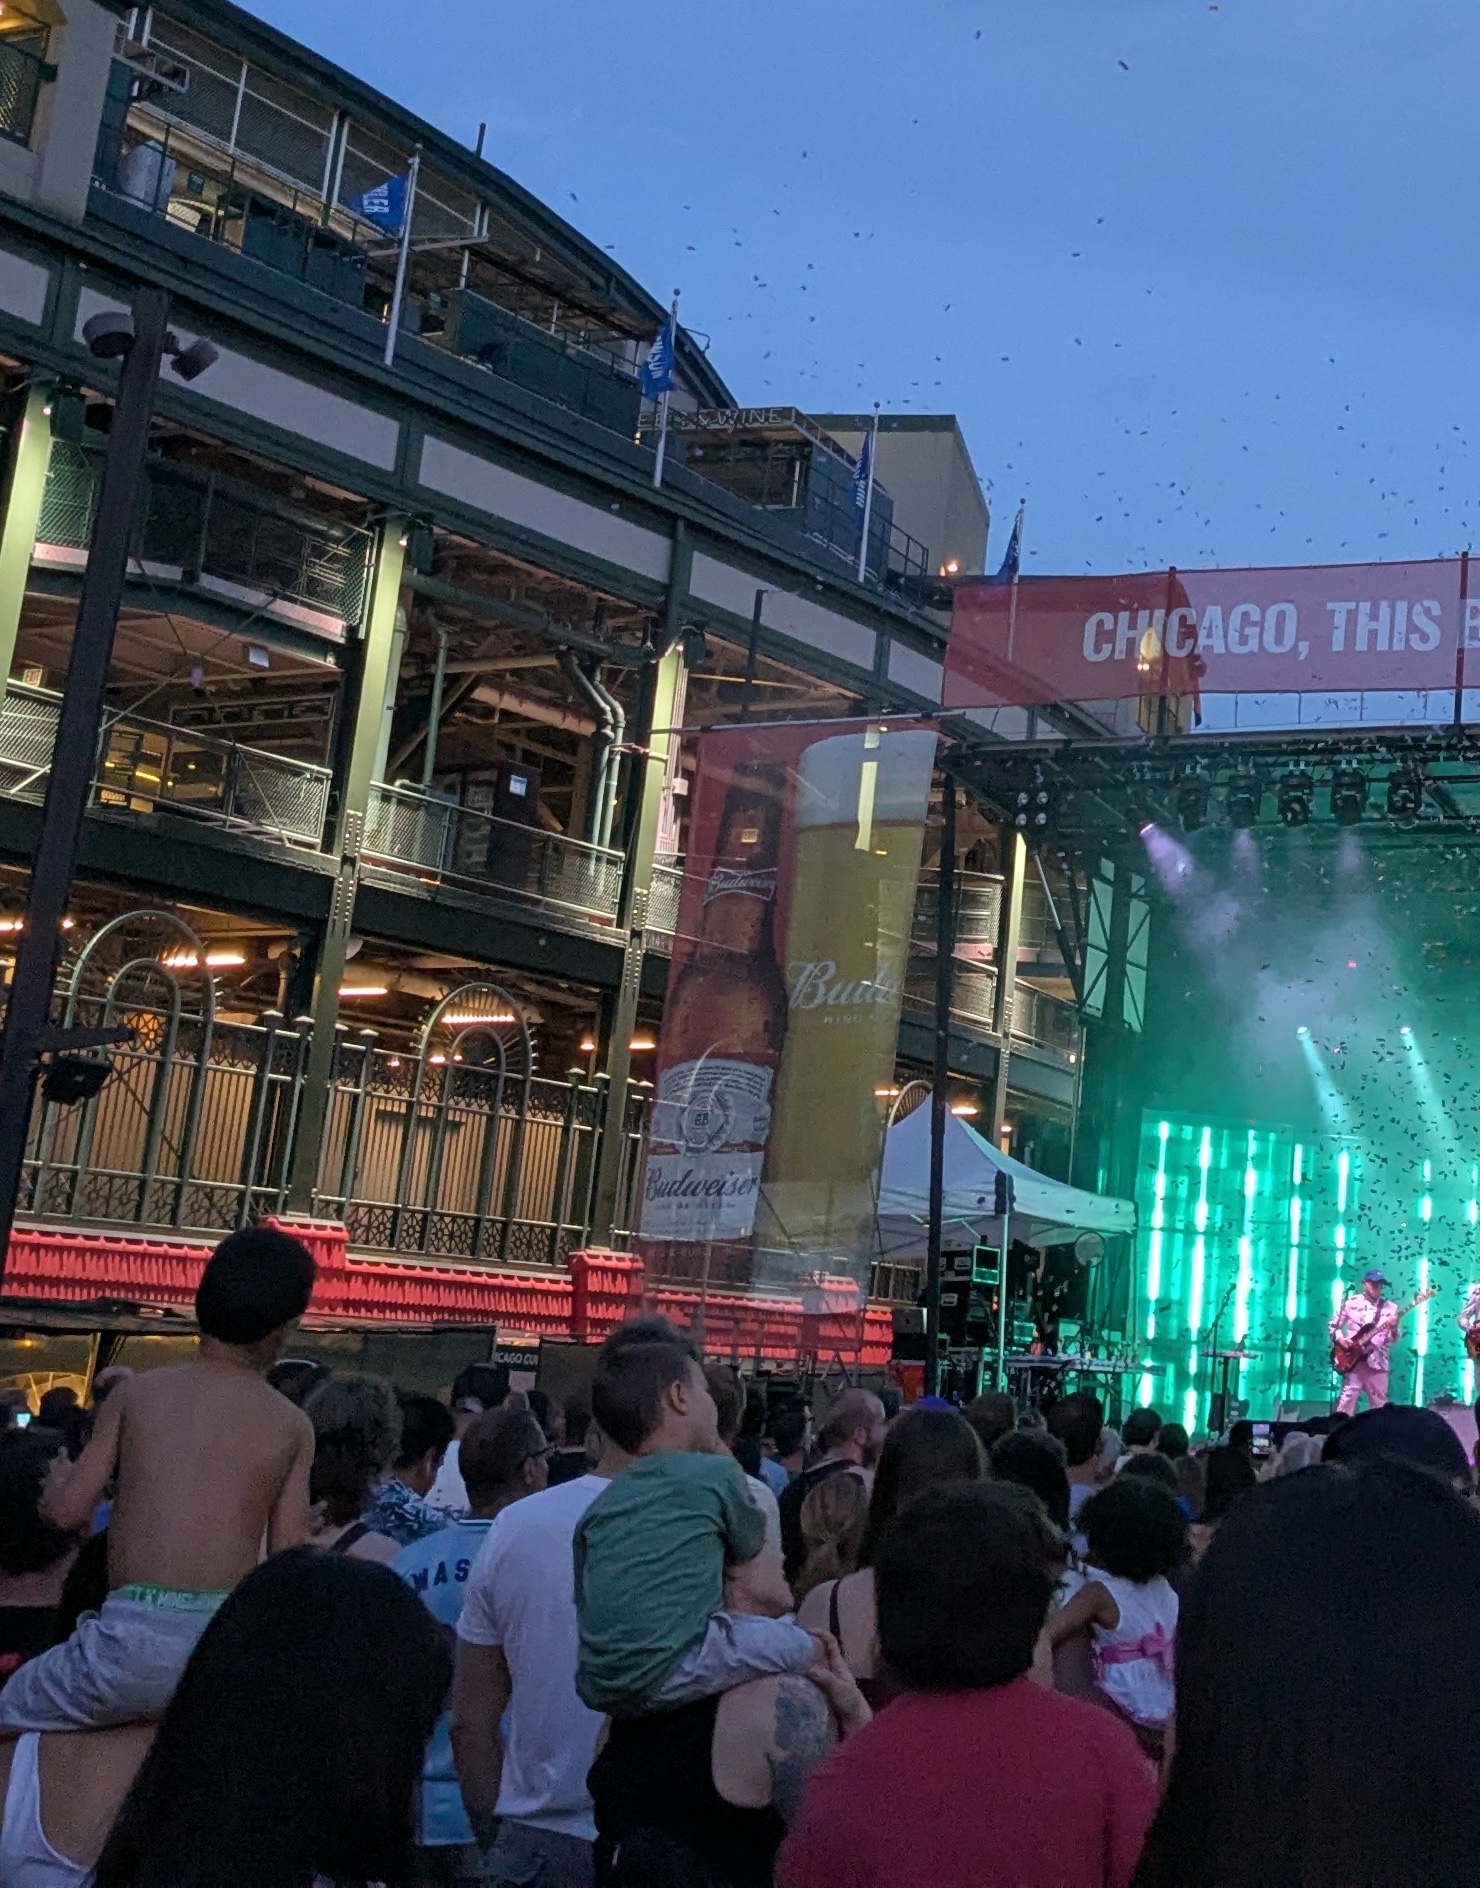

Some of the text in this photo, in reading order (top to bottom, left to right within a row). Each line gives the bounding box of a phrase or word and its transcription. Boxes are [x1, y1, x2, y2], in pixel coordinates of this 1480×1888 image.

[717, 408, 783, 425] WINE
[1082, 602, 1310, 662] CHICAGO,
[1326, 599, 1442, 652] THIS
[644, 1167, 758, 1202] Budweiser
